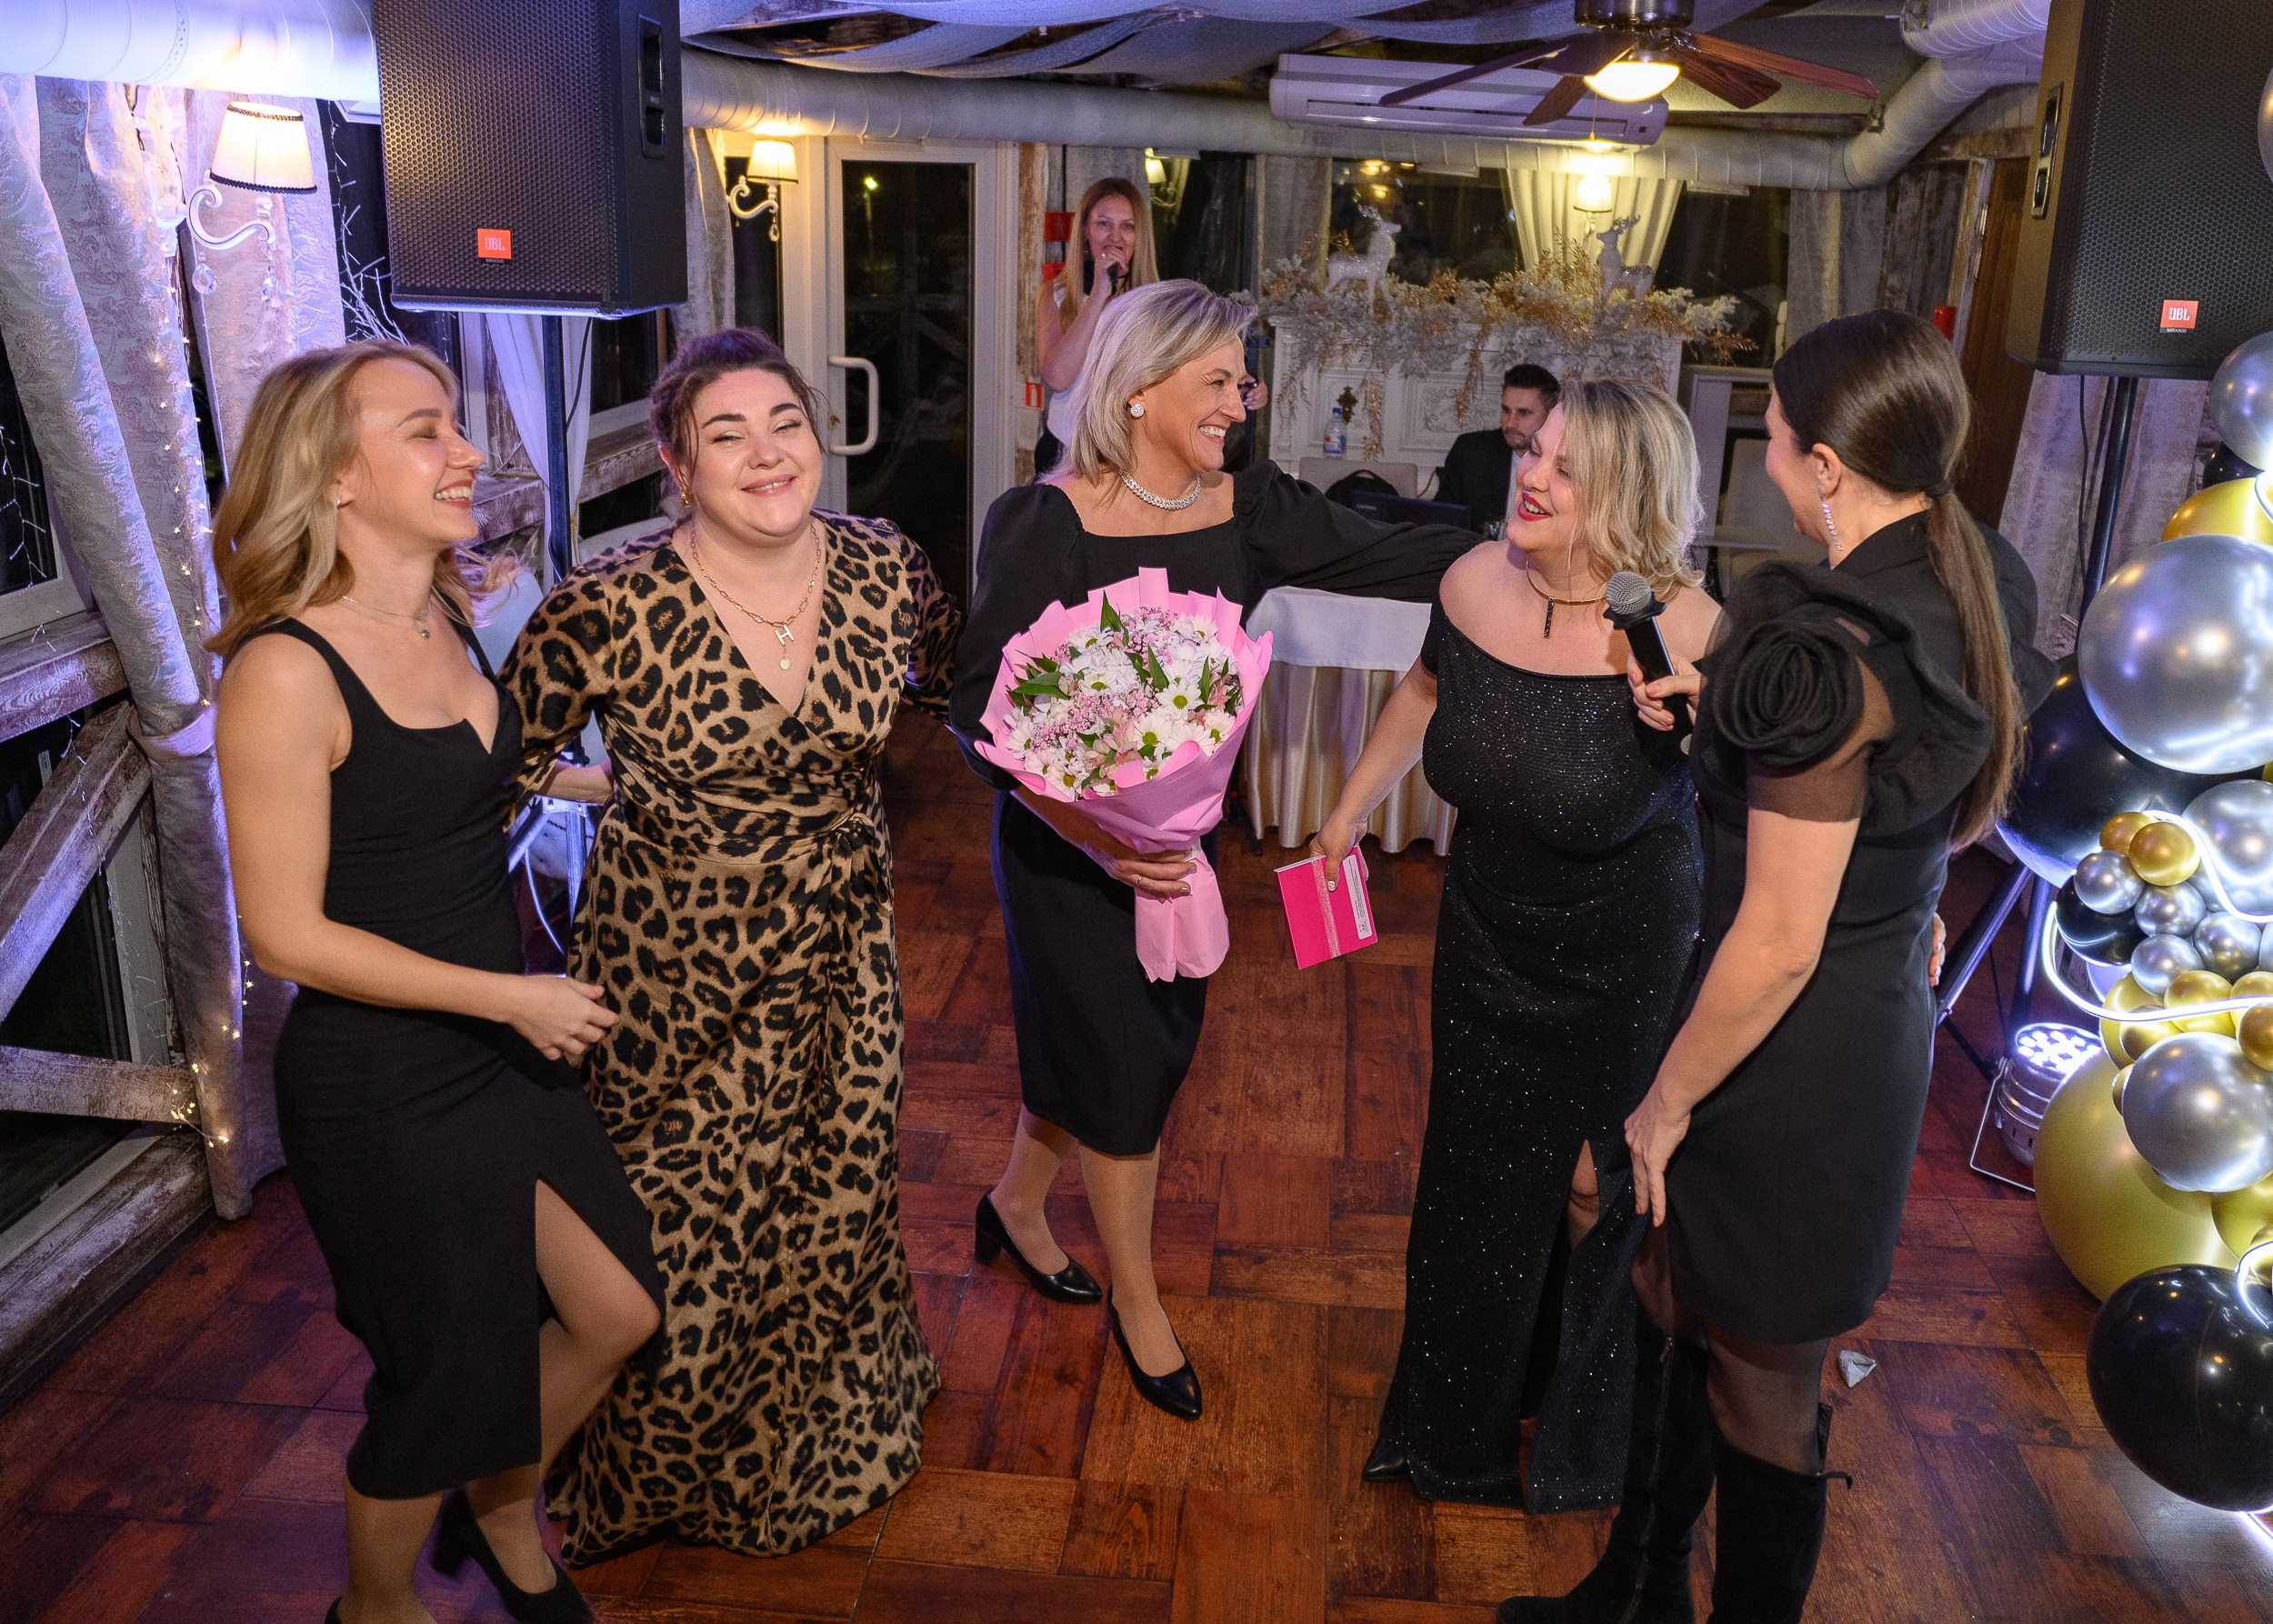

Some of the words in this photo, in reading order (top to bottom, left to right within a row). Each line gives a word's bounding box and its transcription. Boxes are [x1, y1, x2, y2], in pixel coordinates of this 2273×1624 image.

[485, 236, 506, 251] JBL
[2168, 306, 2190, 321] JBL
[775, 623, 795, 647] H
